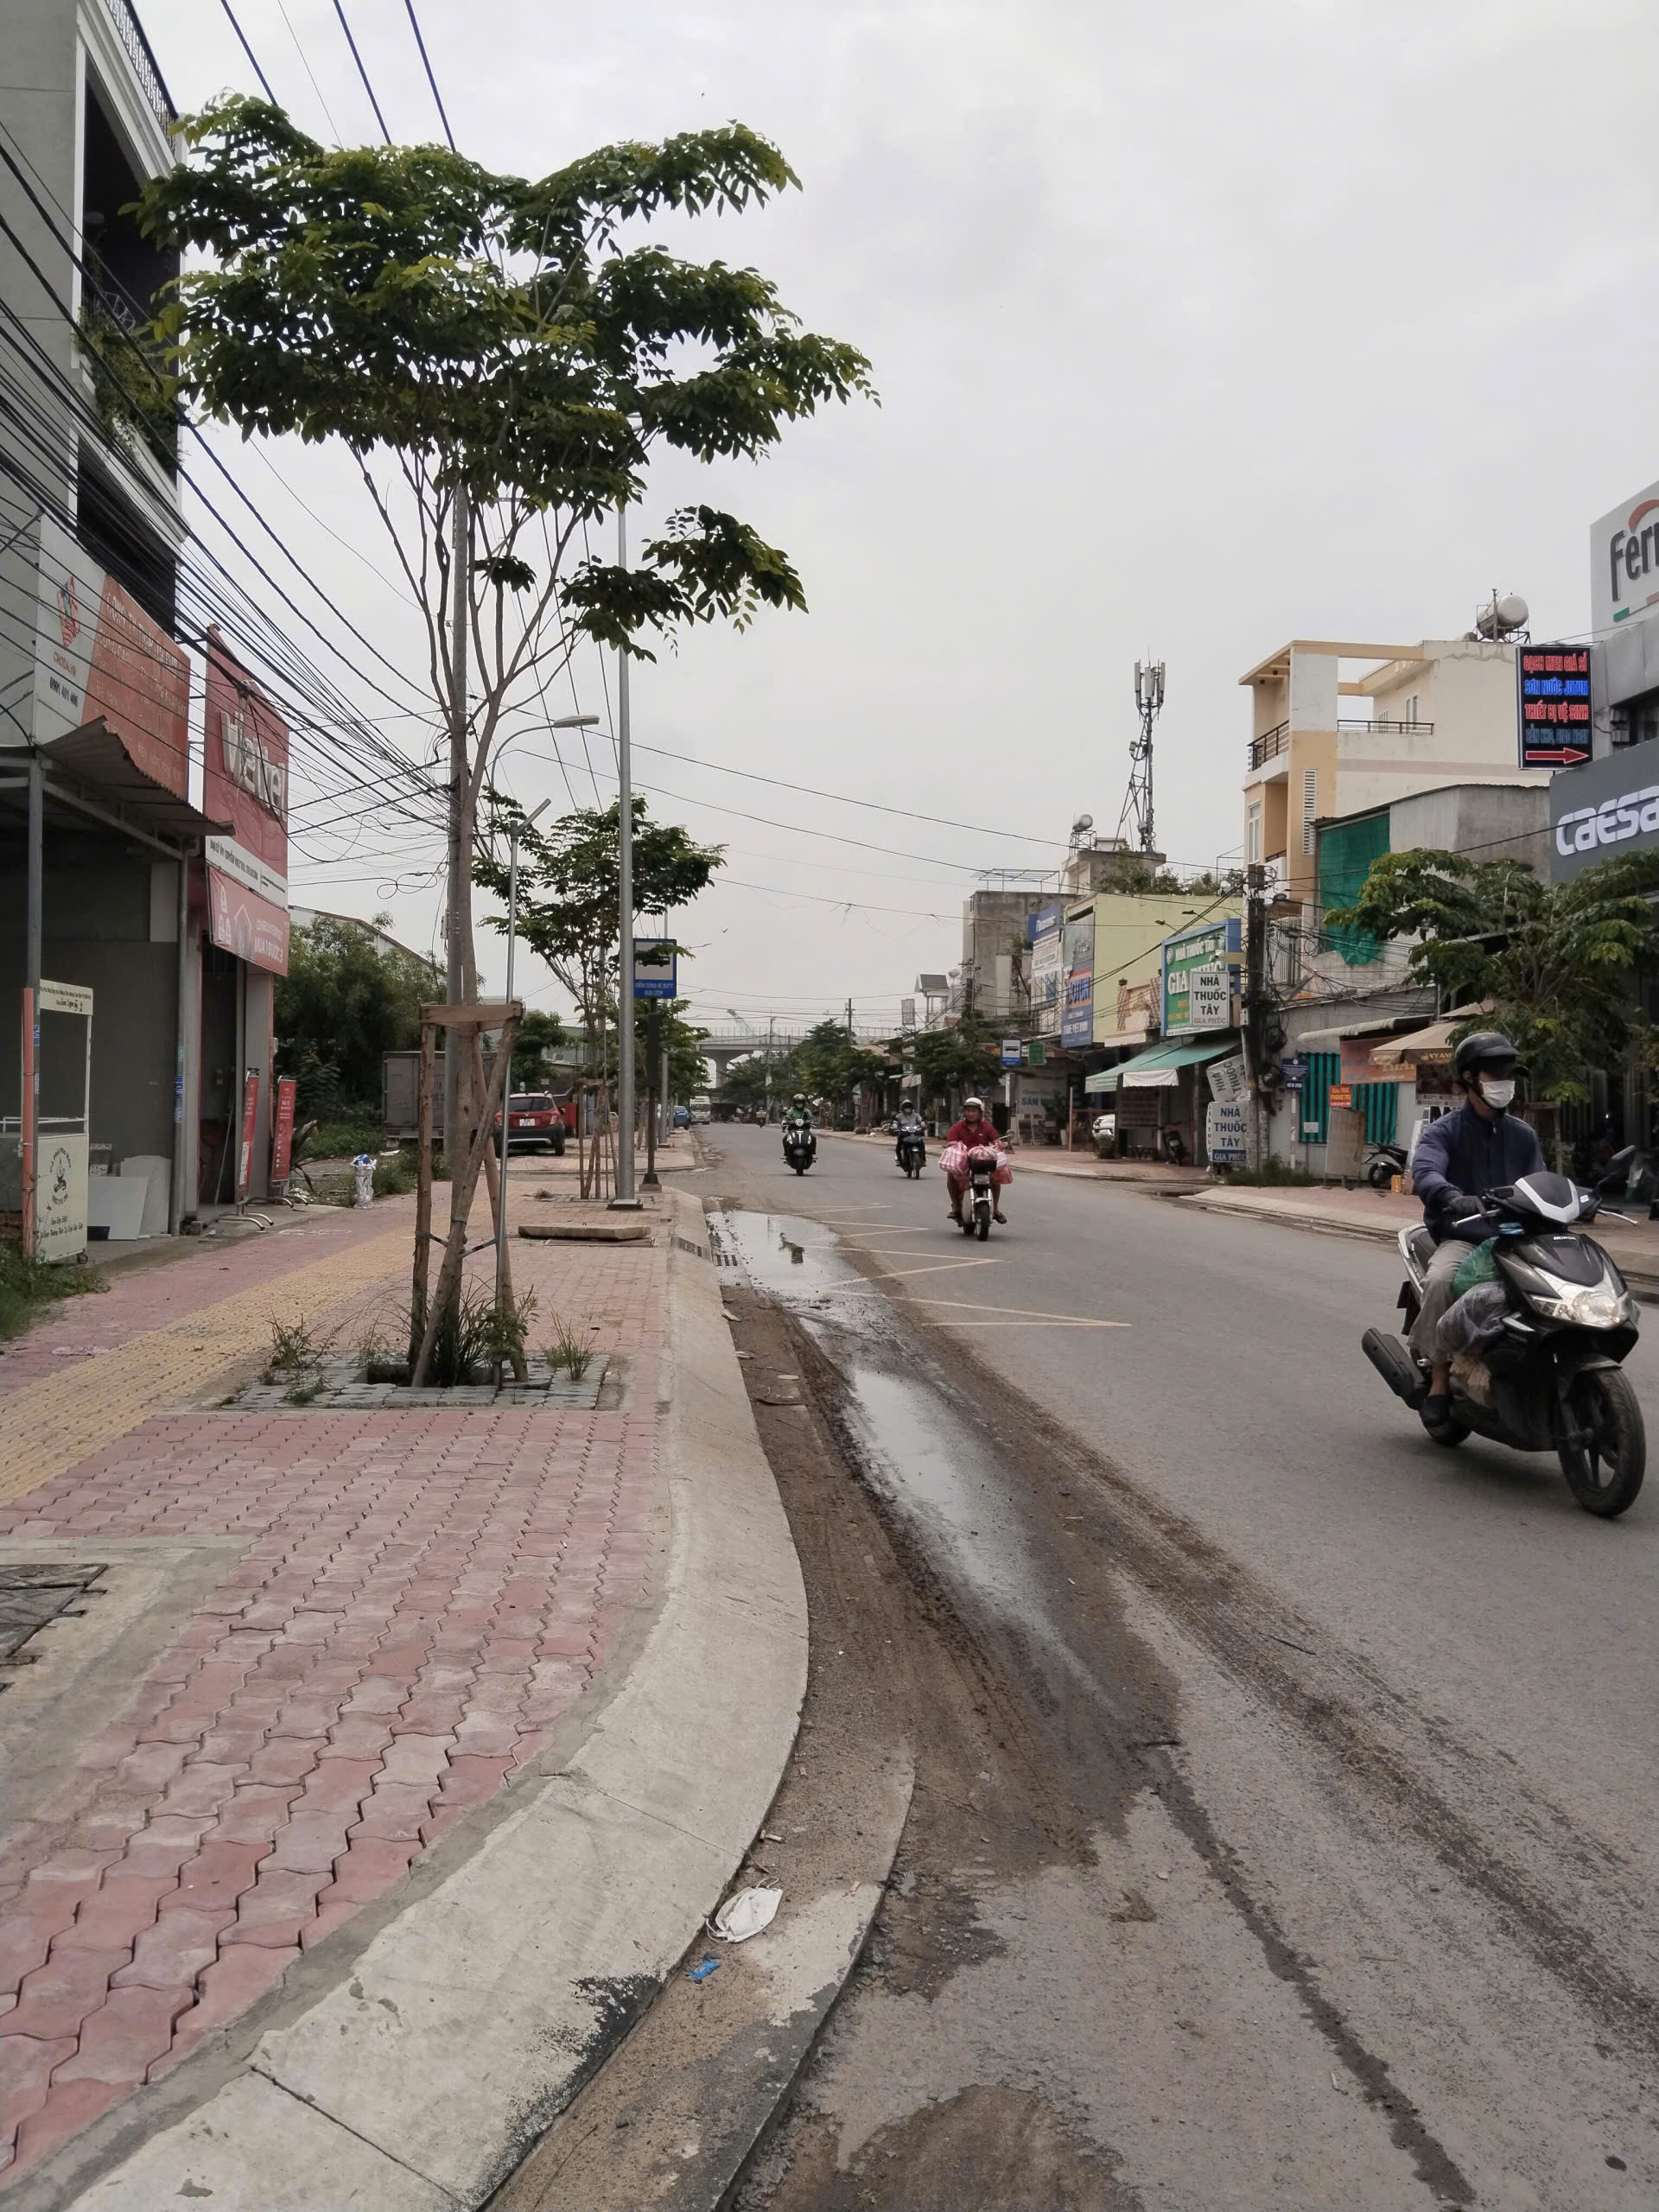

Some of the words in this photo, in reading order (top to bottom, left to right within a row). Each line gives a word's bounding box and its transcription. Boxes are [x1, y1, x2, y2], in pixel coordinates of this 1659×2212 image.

[1564, 680, 1589, 696] JOTUN
[1524, 699, 1547, 720] THIẾT
[1568, 704, 1589, 721] SINH
[1167, 970, 1190, 995] GIA
[1200, 974, 1220, 986] NHÀ
[1194, 988, 1227, 1001] THUỐC
[1200, 1003, 1220, 1015] TÂY
[1211, 1072, 1226, 1092] NHÀ
[1221, 1105, 1241, 1117] NHÀ
[1214, 1119, 1247, 1133] THUỐC
[1220, 1135, 1241, 1147] TÂY
